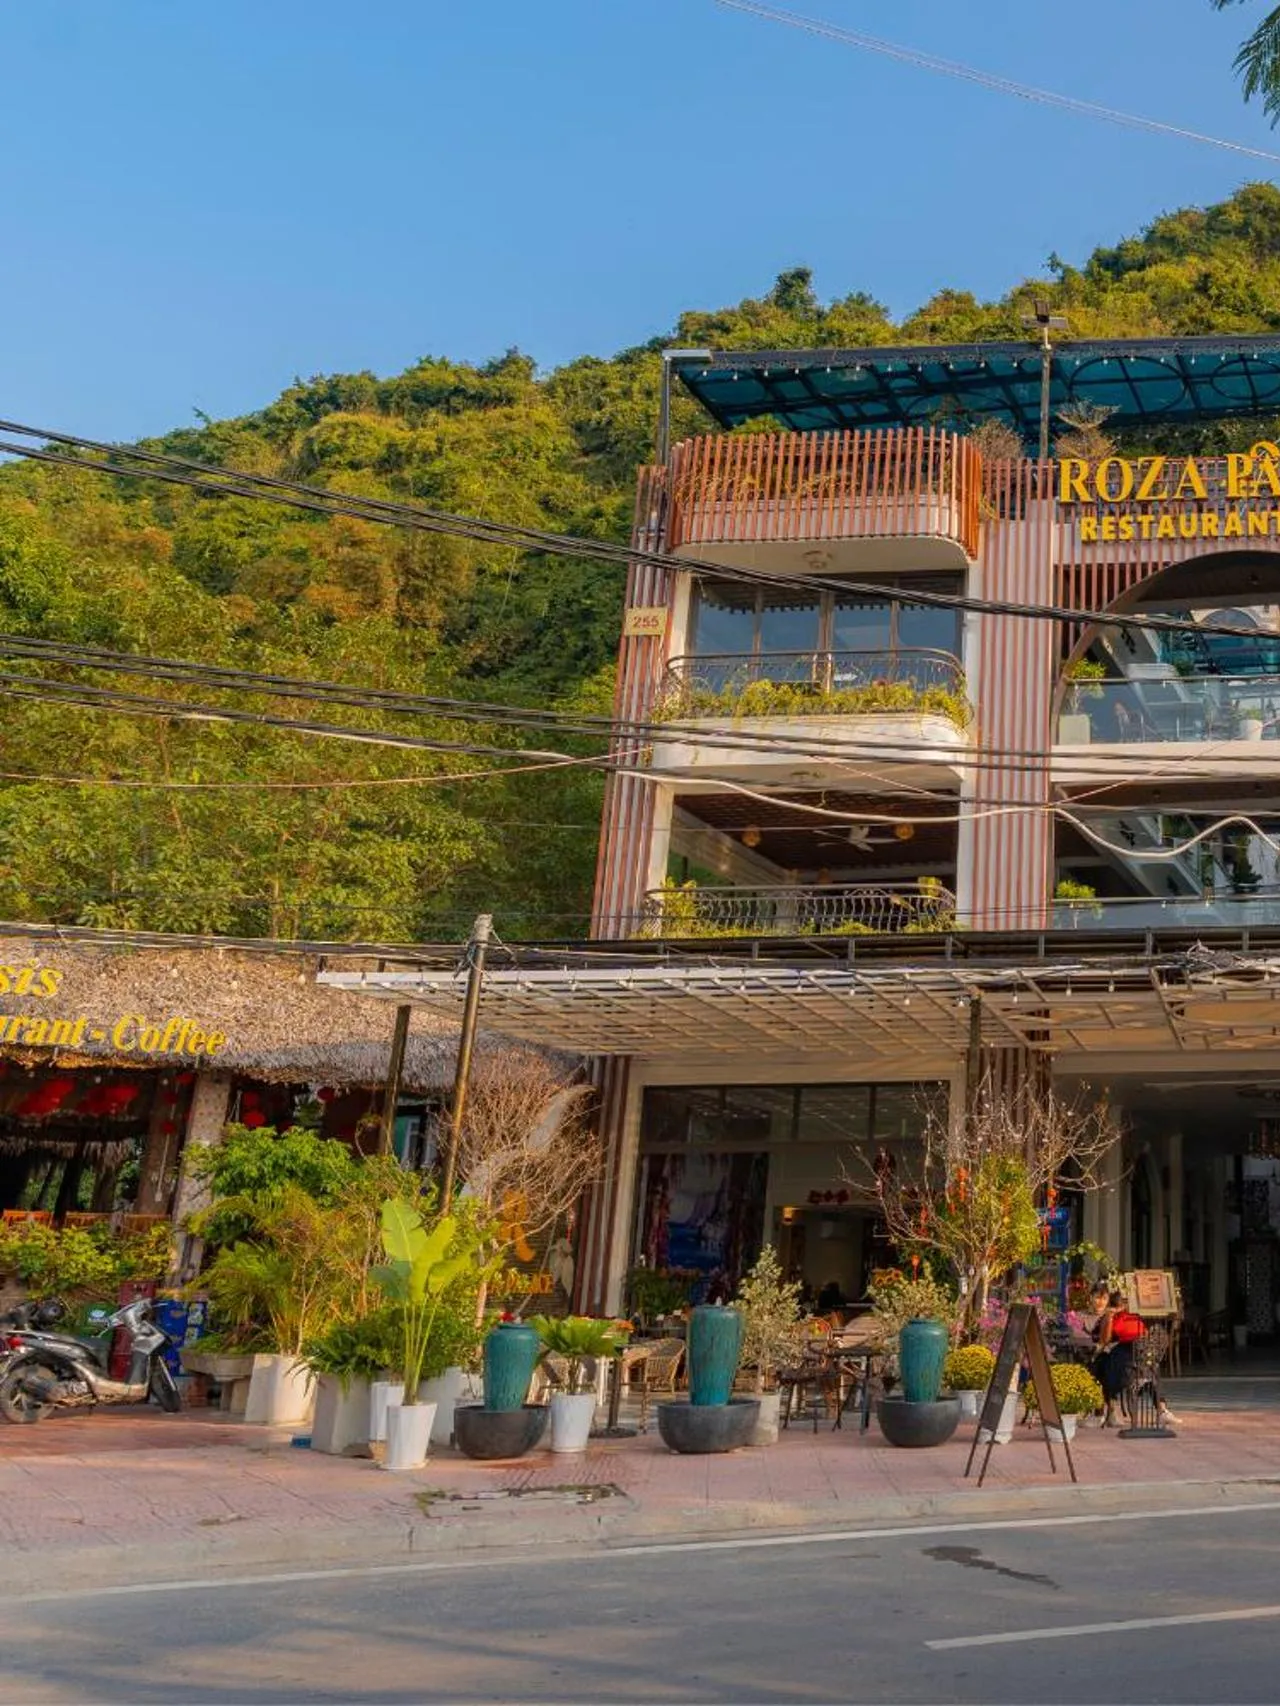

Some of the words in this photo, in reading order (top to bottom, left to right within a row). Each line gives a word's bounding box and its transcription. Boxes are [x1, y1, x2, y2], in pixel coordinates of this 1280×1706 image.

[1059, 455, 1208, 504] ROZA
[631, 615, 660, 629] 255
[112, 1013, 226, 1056] Coffee
